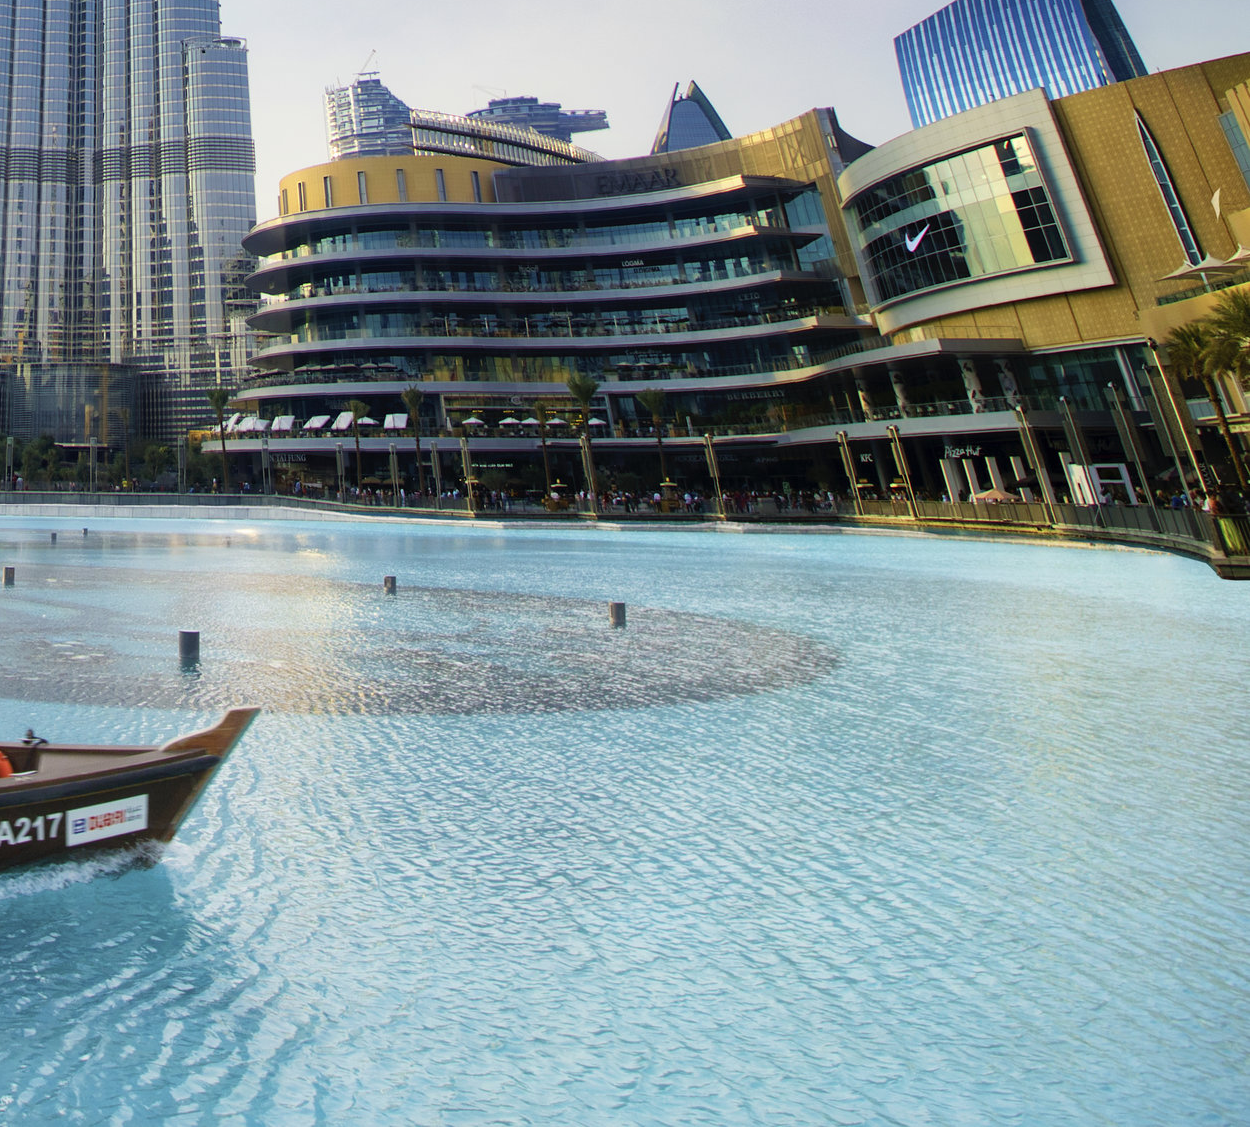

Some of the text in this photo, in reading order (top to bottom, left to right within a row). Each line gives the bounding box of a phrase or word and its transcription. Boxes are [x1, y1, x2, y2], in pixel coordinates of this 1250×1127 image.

[597, 168, 681, 194] EMAAR
[726, 390, 785, 401] BURBERRY
[860, 453, 873, 462] KFC
[944, 444, 982, 459] Pizza Hut
